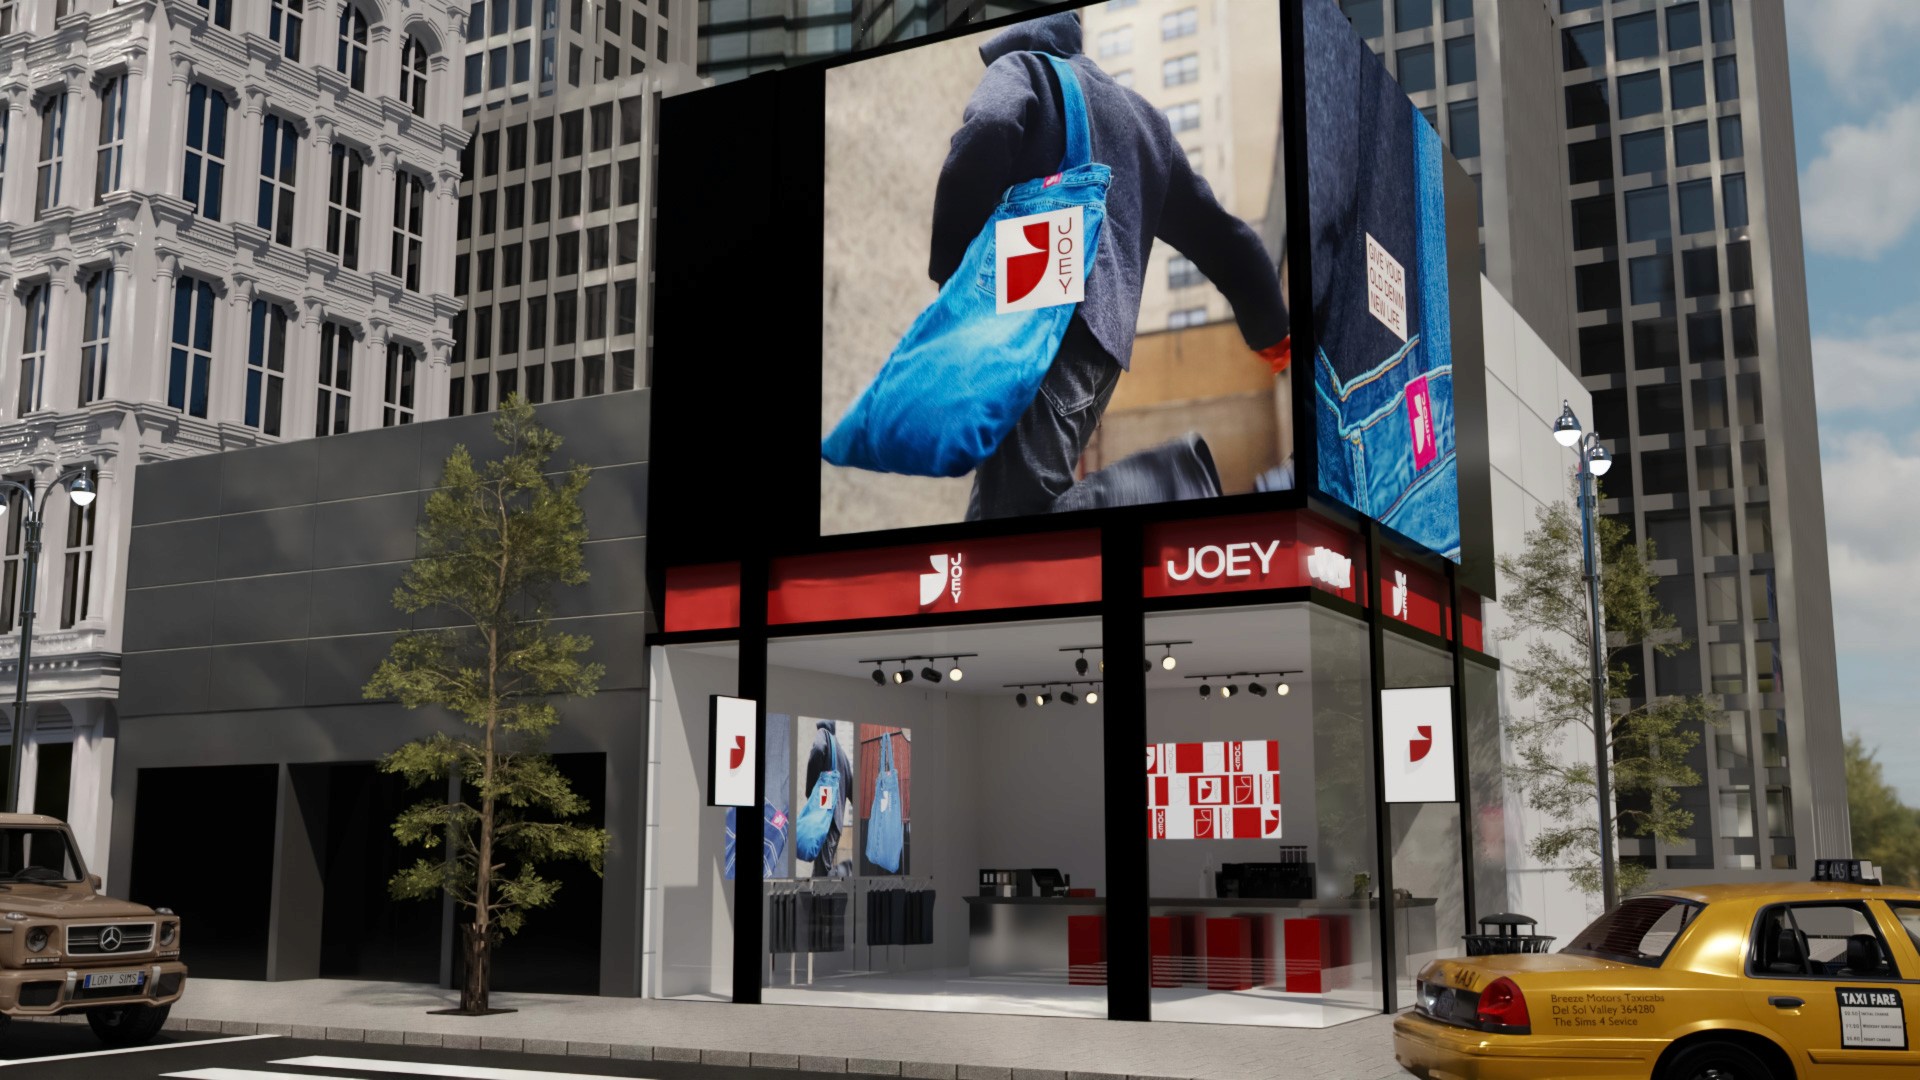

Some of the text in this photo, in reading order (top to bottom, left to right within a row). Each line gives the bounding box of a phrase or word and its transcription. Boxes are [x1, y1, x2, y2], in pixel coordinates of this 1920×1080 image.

[1057, 216, 1073, 295] JOEY
[1368, 242, 1402, 287] GIVE YOUR
[1369, 267, 1405, 312] OLD DENIM
[1370, 290, 1400, 330] NEW LIFE
[1422, 391, 1432, 447] JOEY
[950, 552, 963, 604] JOEY
[1167, 539, 1280, 581] JOEY
[1234, 743, 1242, 771] JOEY
[91, 973, 137, 986] LORY SIMS
[1551, 993, 1665, 1003] Breeze Motors Taxicabs
[1841, 992, 1897, 1006] TAXI FARE
[1552, 1004, 1656, 1016] Del Sol Valley 364280
[1552, 1017, 1639, 1027] The Sims 4 Sevice
